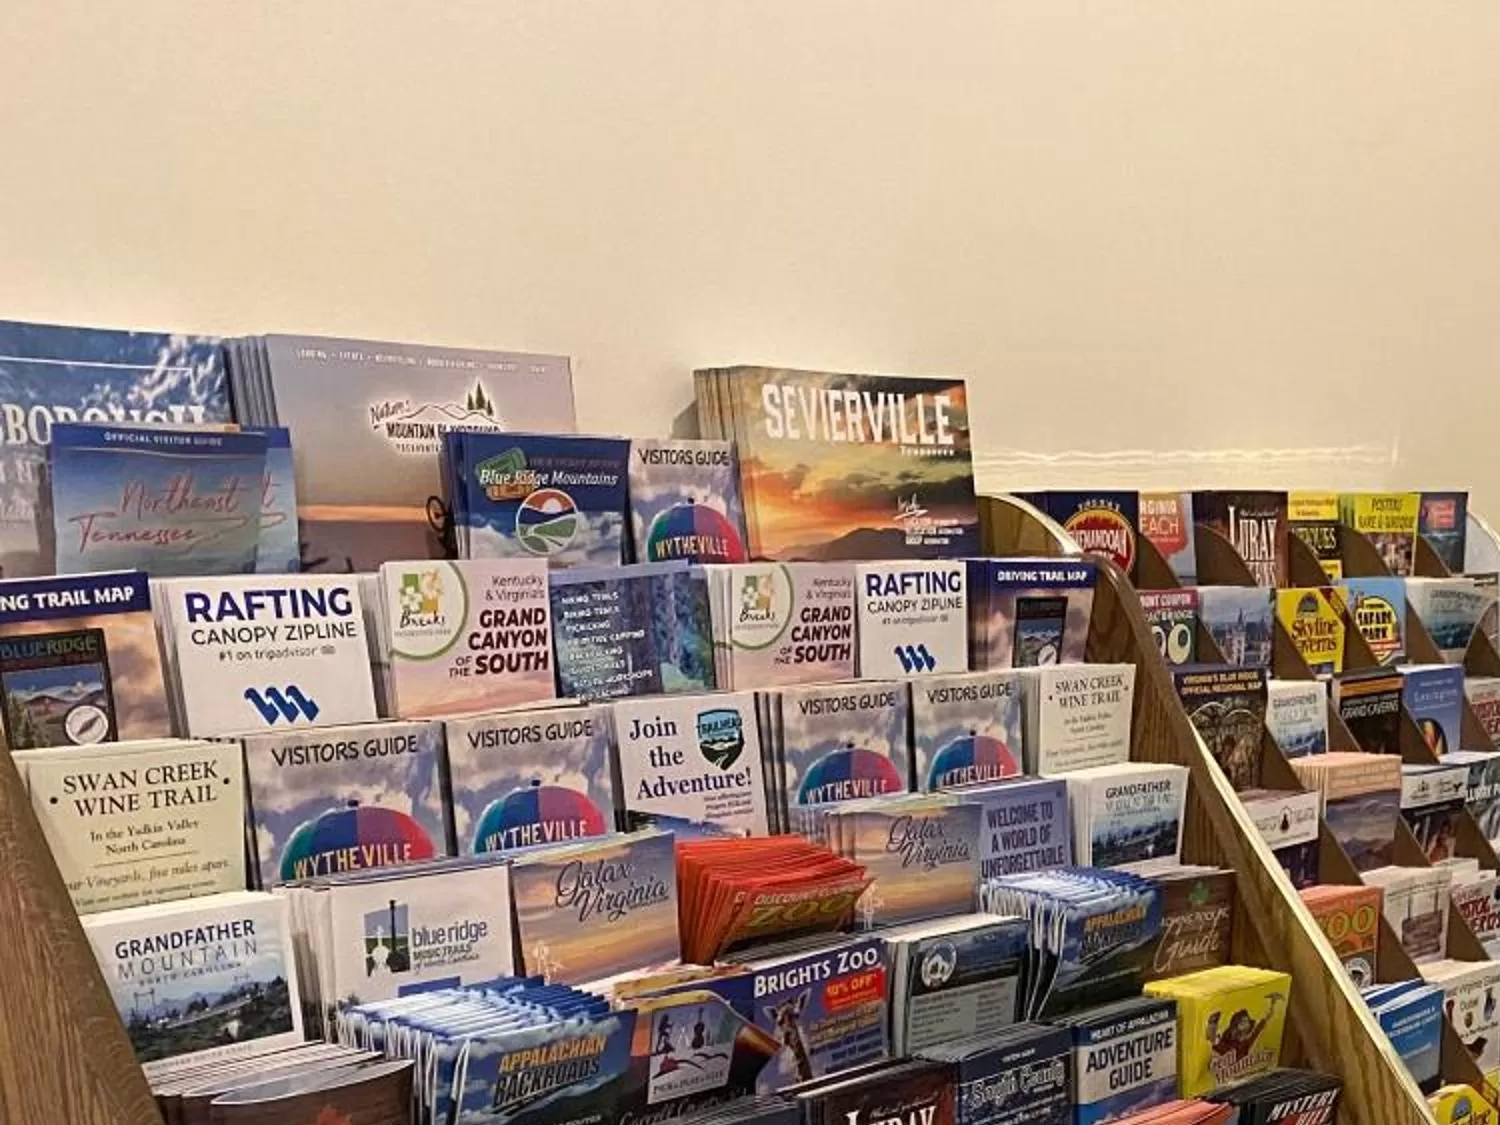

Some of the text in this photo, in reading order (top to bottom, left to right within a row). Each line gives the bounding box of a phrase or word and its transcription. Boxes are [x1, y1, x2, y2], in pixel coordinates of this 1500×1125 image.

[762, 383, 954, 445] SEVIERVILLE
[104, 432, 222, 446] OFFICIAL VISITOR GUIDE
[638, 449, 693, 465] VISITORS
[696, 451, 730, 466] GUIDE
[480, 470, 618, 487] Blue Ridge Mountains
[122, 473, 242, 516] Northeast
[69, 512, 203, 552] Tennessee
[1228, 505, 1278, 561] LURAY
[655, 536, 729, 556] WYTHEVILLE
[492, 576, 544, 588] Kentucky
[866, 571, 962, 596] RAFTING
[998, 569, 1065, 582] DRIVING TRAIL
[33, 590, 90, 609] TRAIL
[94, 586, 134, 604] MAP
[185, 586, 352, 622] RAFTING
[868, 598, 962, 614] CANOPY ZIPLINE
[479, 607, 547, 629] GRAND
[801, 607, 851, 622] GRAND
[191, 622, 357, 646] CANOPY ZIPLINE
[468, 629, 547, 651] CANYON
[791, 624, 851, 642] CANYON
[1292, 619, 1339, 640] Skyline
[449, 652, 549, 678] THE SOUTH
[455, 656, 473, 666] OF
[794, 643, 850, 663] SOUTH
[927, 681, 1013, 704] VISITORS GUIDE
[1055, 673, 1124, 694] SWAN CREEK
[800, 692, 896, 715] VISITORS GUIDE
[1060, 690, 1121, 709] WINE TRAIL
[467, 719, 594, 749] VISITORS GUIDE
[629, 717, 678, 741] Join
[271, 735, 417, 768] VISITORS GUIDE
[649, 748, 683, 767] the
[63, 761, 218, 795] SWAN CREEK
[637, 767, 752, 800] Adventure!
[1106, 779, 1171, 798] GRANDFATHER
[74, 785, 217, 817] WINE TRAIL
[805, 779, 889, 804] WYTHEVILLE
[987, 801, 1052, 828] WELCOME TO
[485, 820, 587, 852] WYTHEVILLE
[991, 827, 1051, 850] A WORLD OF
[293, 841, 411, 876] WYTHEVILLE
[901, 834, 972, 869] Virginia
[981, 848, 1066, 874] UNFORGETTABLE
[555, 860, 634, 908] Galax
[579, 874, 669, 922] Virginia
[1084, 906, 1148, 932] APPALACHIAN
[115, 920, 256, 959] GRANDFATHER
[412, 920, 488, 947] blue ridge
[116, 940, 257, 981] MOUNTAIN
[754, 948, 878, 999] BRIGHTS ZOO
[499, 1034, 608, 1076] APPALACHIAN
[1086, 1028, 1173, 1073] ADVENTURE
[1109, 1058, 1152, 1091] GUIDE
[1265, 1088, 1340, 1123] MYSTERY
